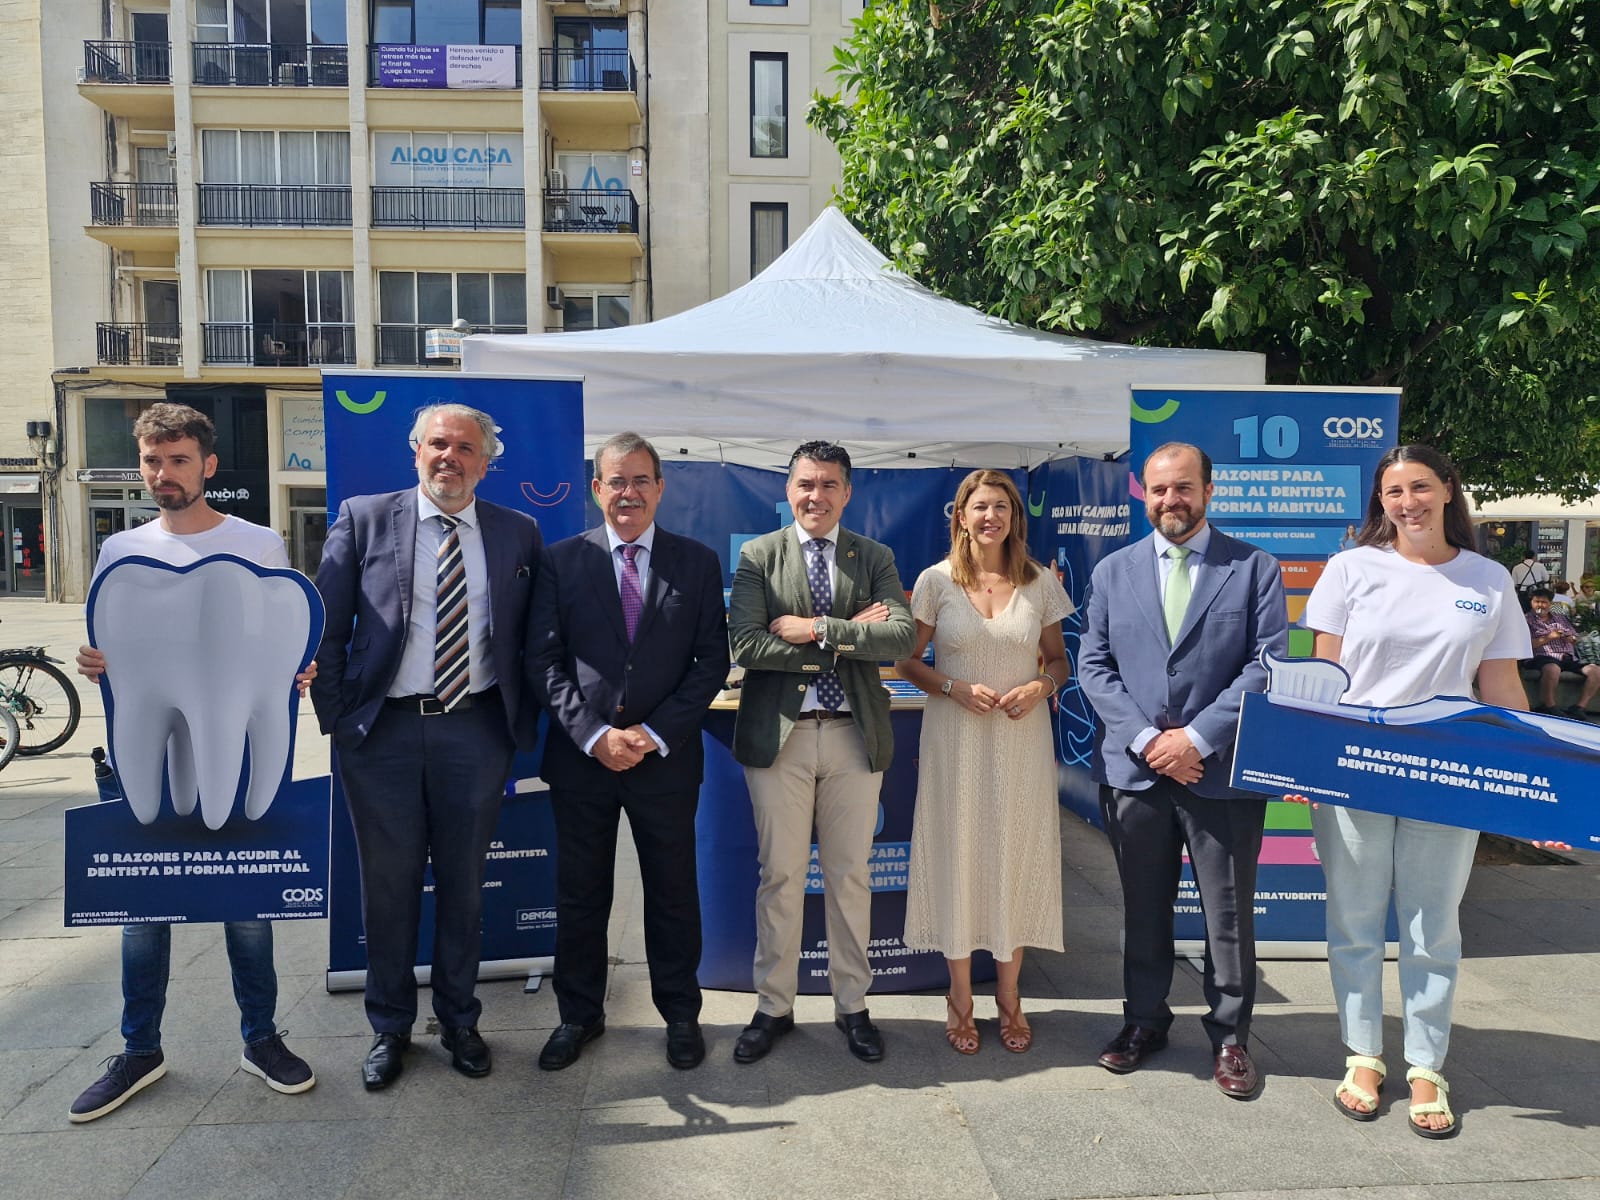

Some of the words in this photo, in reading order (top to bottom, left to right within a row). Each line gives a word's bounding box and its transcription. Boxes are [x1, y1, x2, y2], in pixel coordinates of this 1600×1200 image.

[391, 146, 513, 164] ALQUCASA
[1323, 416, 1384, 439] CODS
[1233, 415, 1300, 459] 10
[1210, 469, 1279, 482] RAZONES
[1282, 470, 1324, 482] PARA
[1248, 486, 1267, 498] AL
[1271, 486, 1346, 498] DENTISTA
[1082, 504, 1117, 519] CAMINO
[1210, 501, 1264, 514] FORMA
[1267, 501, 1345, 514] HABITUAL
[1235, 531, 1245, 539] ES
[1245, 531, 1272, 539] MEJOR
[1272, 531, 1289, 539] QUE
[1289, 531, 1316, 539] CURAR
[1455, 599, 1487, 614] CODS
[1344, 745, 1360, 756] 10
[1362, 747, 1428, 768] RAZONES
[1430, 759, 1470, 775] PARA
[1473, 766, 1528, 784] ACUDIR
[1531, 775, 1551, 788] AL
[1337, 757, 1406, 778] DENTISTA
[1409, 769, 1428, 782] DE
[1430, 773, 1480, 791] FORMA
[1483, 781, 1559, 803] HABITUAL
[93, 853, 109, 863] 10
[112, 852, 180, 863] RAZONES
[183, 851, 224, 862] PARA
[226, 850, 280, 861] ACUDIR
[284, 849, 302, 860] AL
[870, 847, 906, 858] PARA
[87, 865, 160, 877] DENTISTA
[163, 864, 182, 876] DE
[185, 864, 235, 875] FORMA
[238, 862, 310, 874] HABITUAL
[282, 888, 324, 902] CODS
